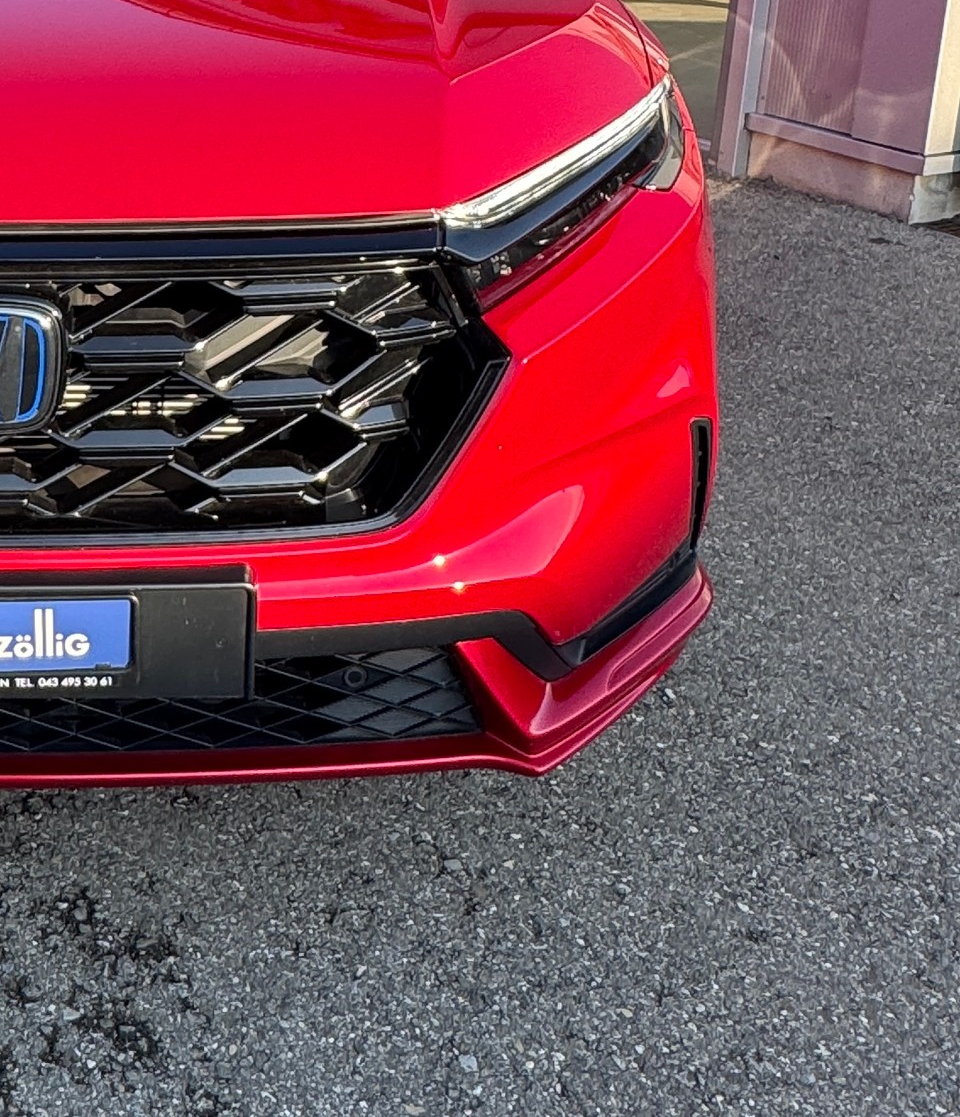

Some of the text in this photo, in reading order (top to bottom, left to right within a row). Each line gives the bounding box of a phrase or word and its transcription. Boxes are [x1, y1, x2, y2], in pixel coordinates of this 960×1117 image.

[38, 676, 59, 688] 043
[60, 676, 81, 688] 495
[83, 676, 98, 687] 30
[100, 676, 113, 687] 61
